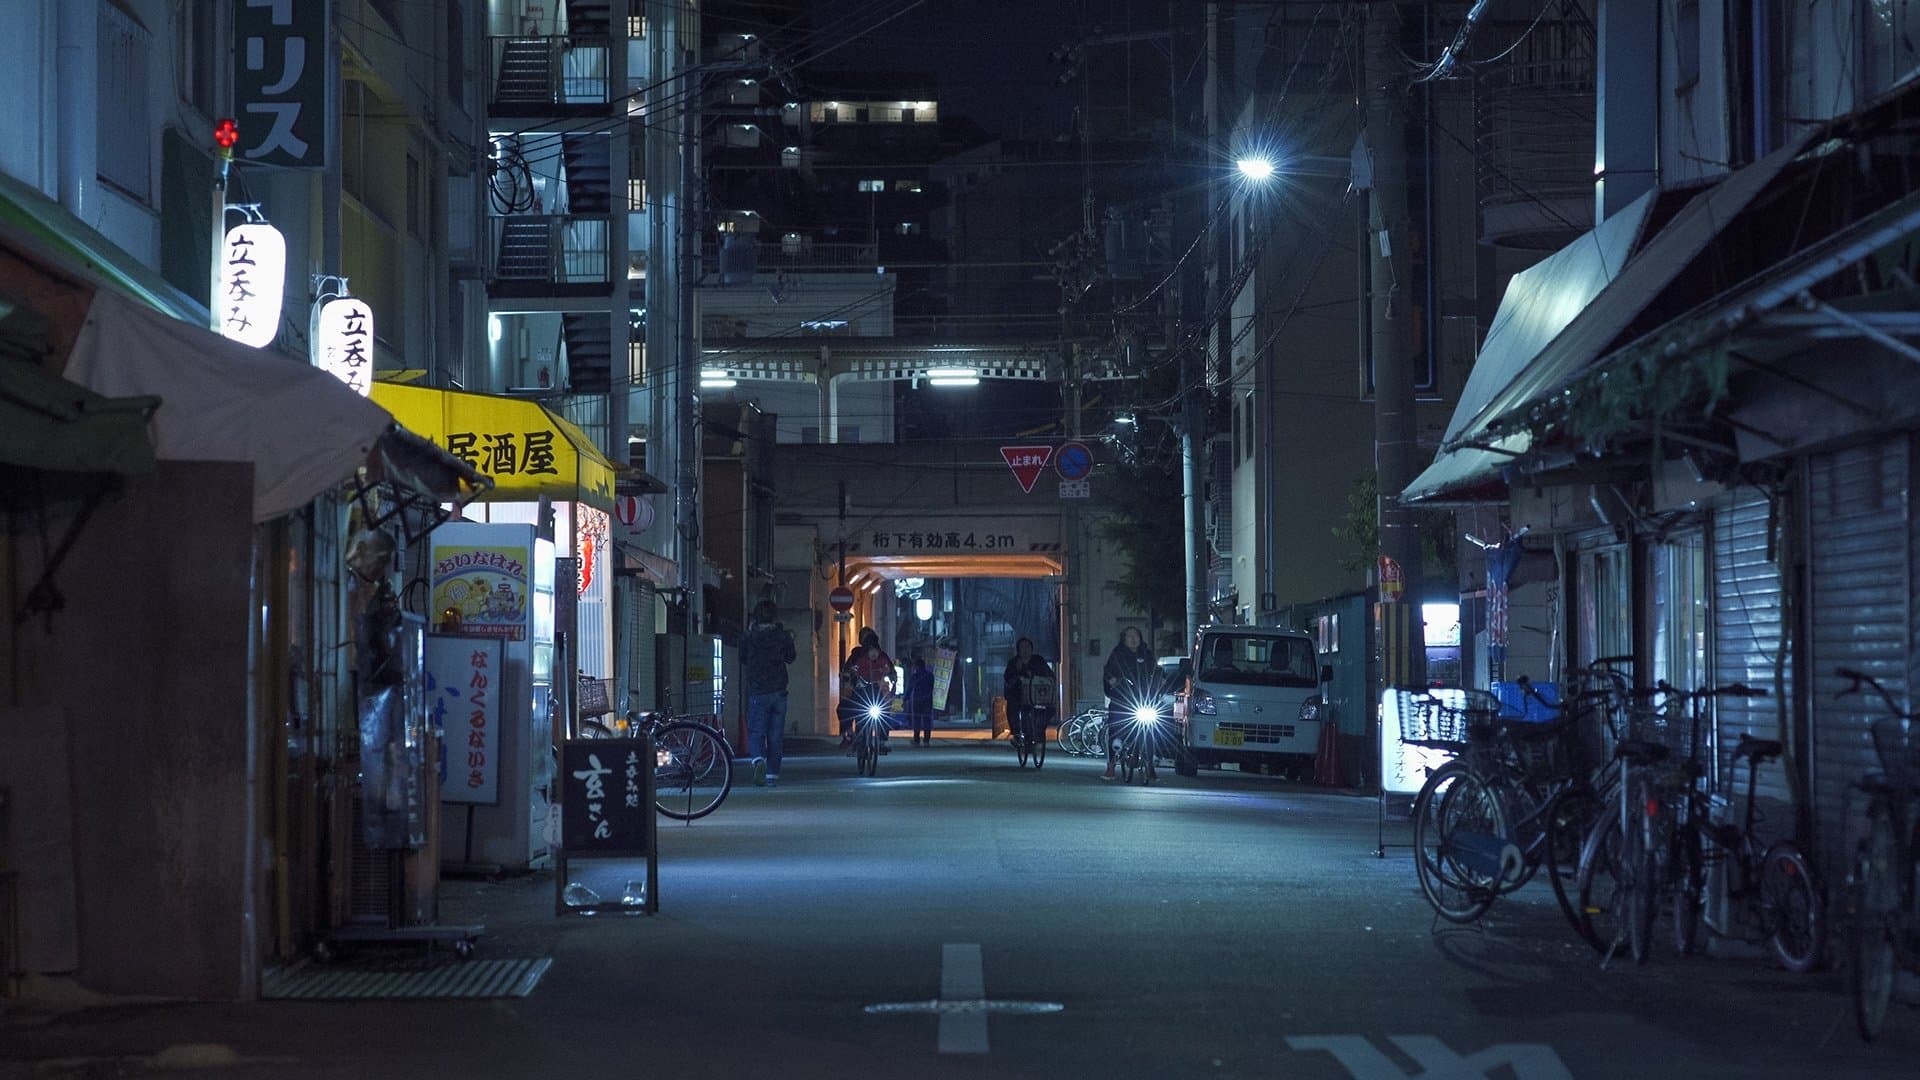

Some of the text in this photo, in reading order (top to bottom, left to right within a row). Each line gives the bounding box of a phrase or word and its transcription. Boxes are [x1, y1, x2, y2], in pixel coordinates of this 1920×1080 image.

[227, 234, 257, 332] 立呑み
[341, 308, 369, 392] 立呑み
[446, 430, 559, 476] 居酒屋
[1012, 454, 1043, 467] 止まれ
[873, 531, 1015, 549] 桁下有効高4.3m
[467, 649, 489, 790] なんくるないさ
